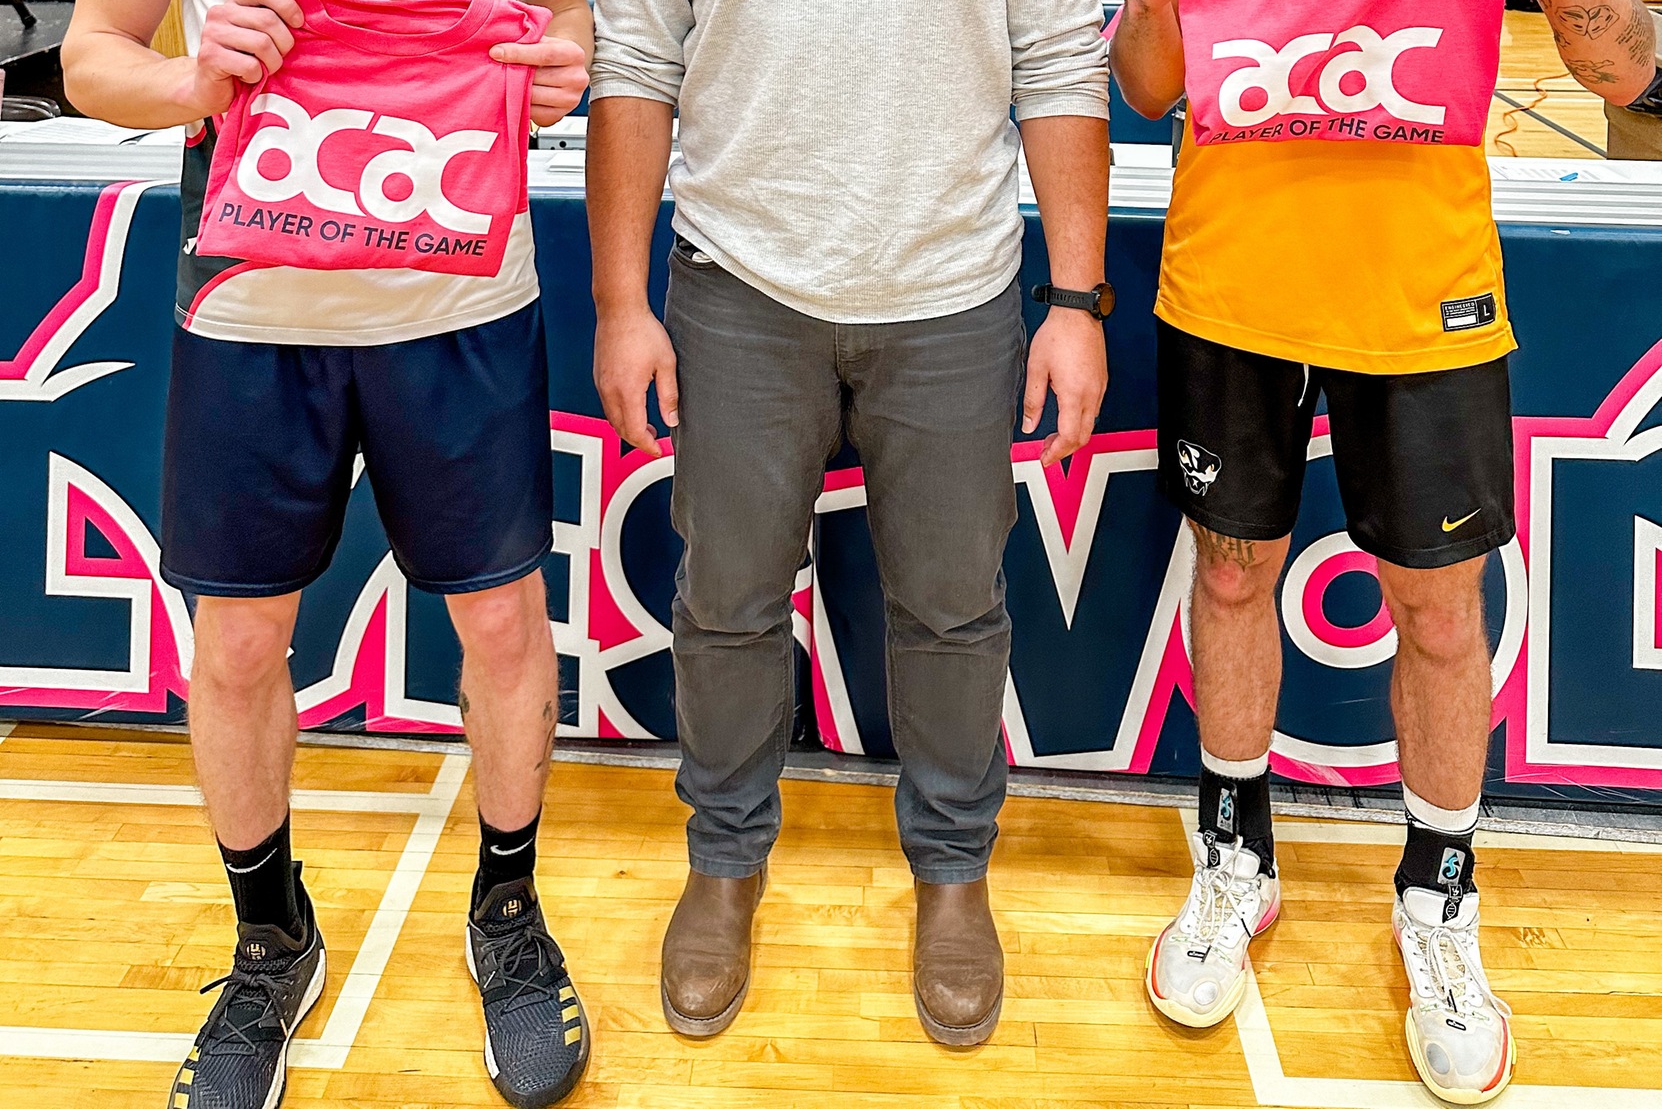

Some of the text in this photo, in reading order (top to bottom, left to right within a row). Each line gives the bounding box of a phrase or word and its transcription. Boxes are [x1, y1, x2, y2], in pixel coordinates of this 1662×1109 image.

[1212, 24, 1446, 127] acac
[1209, 117, 1445, 143] PLAYER OF THE GAME
[236, 92, 497, 234] acac
[218, 202, 487, 256] PLAYER OF THE GAME
[1483, 304, 1490, 317] L
